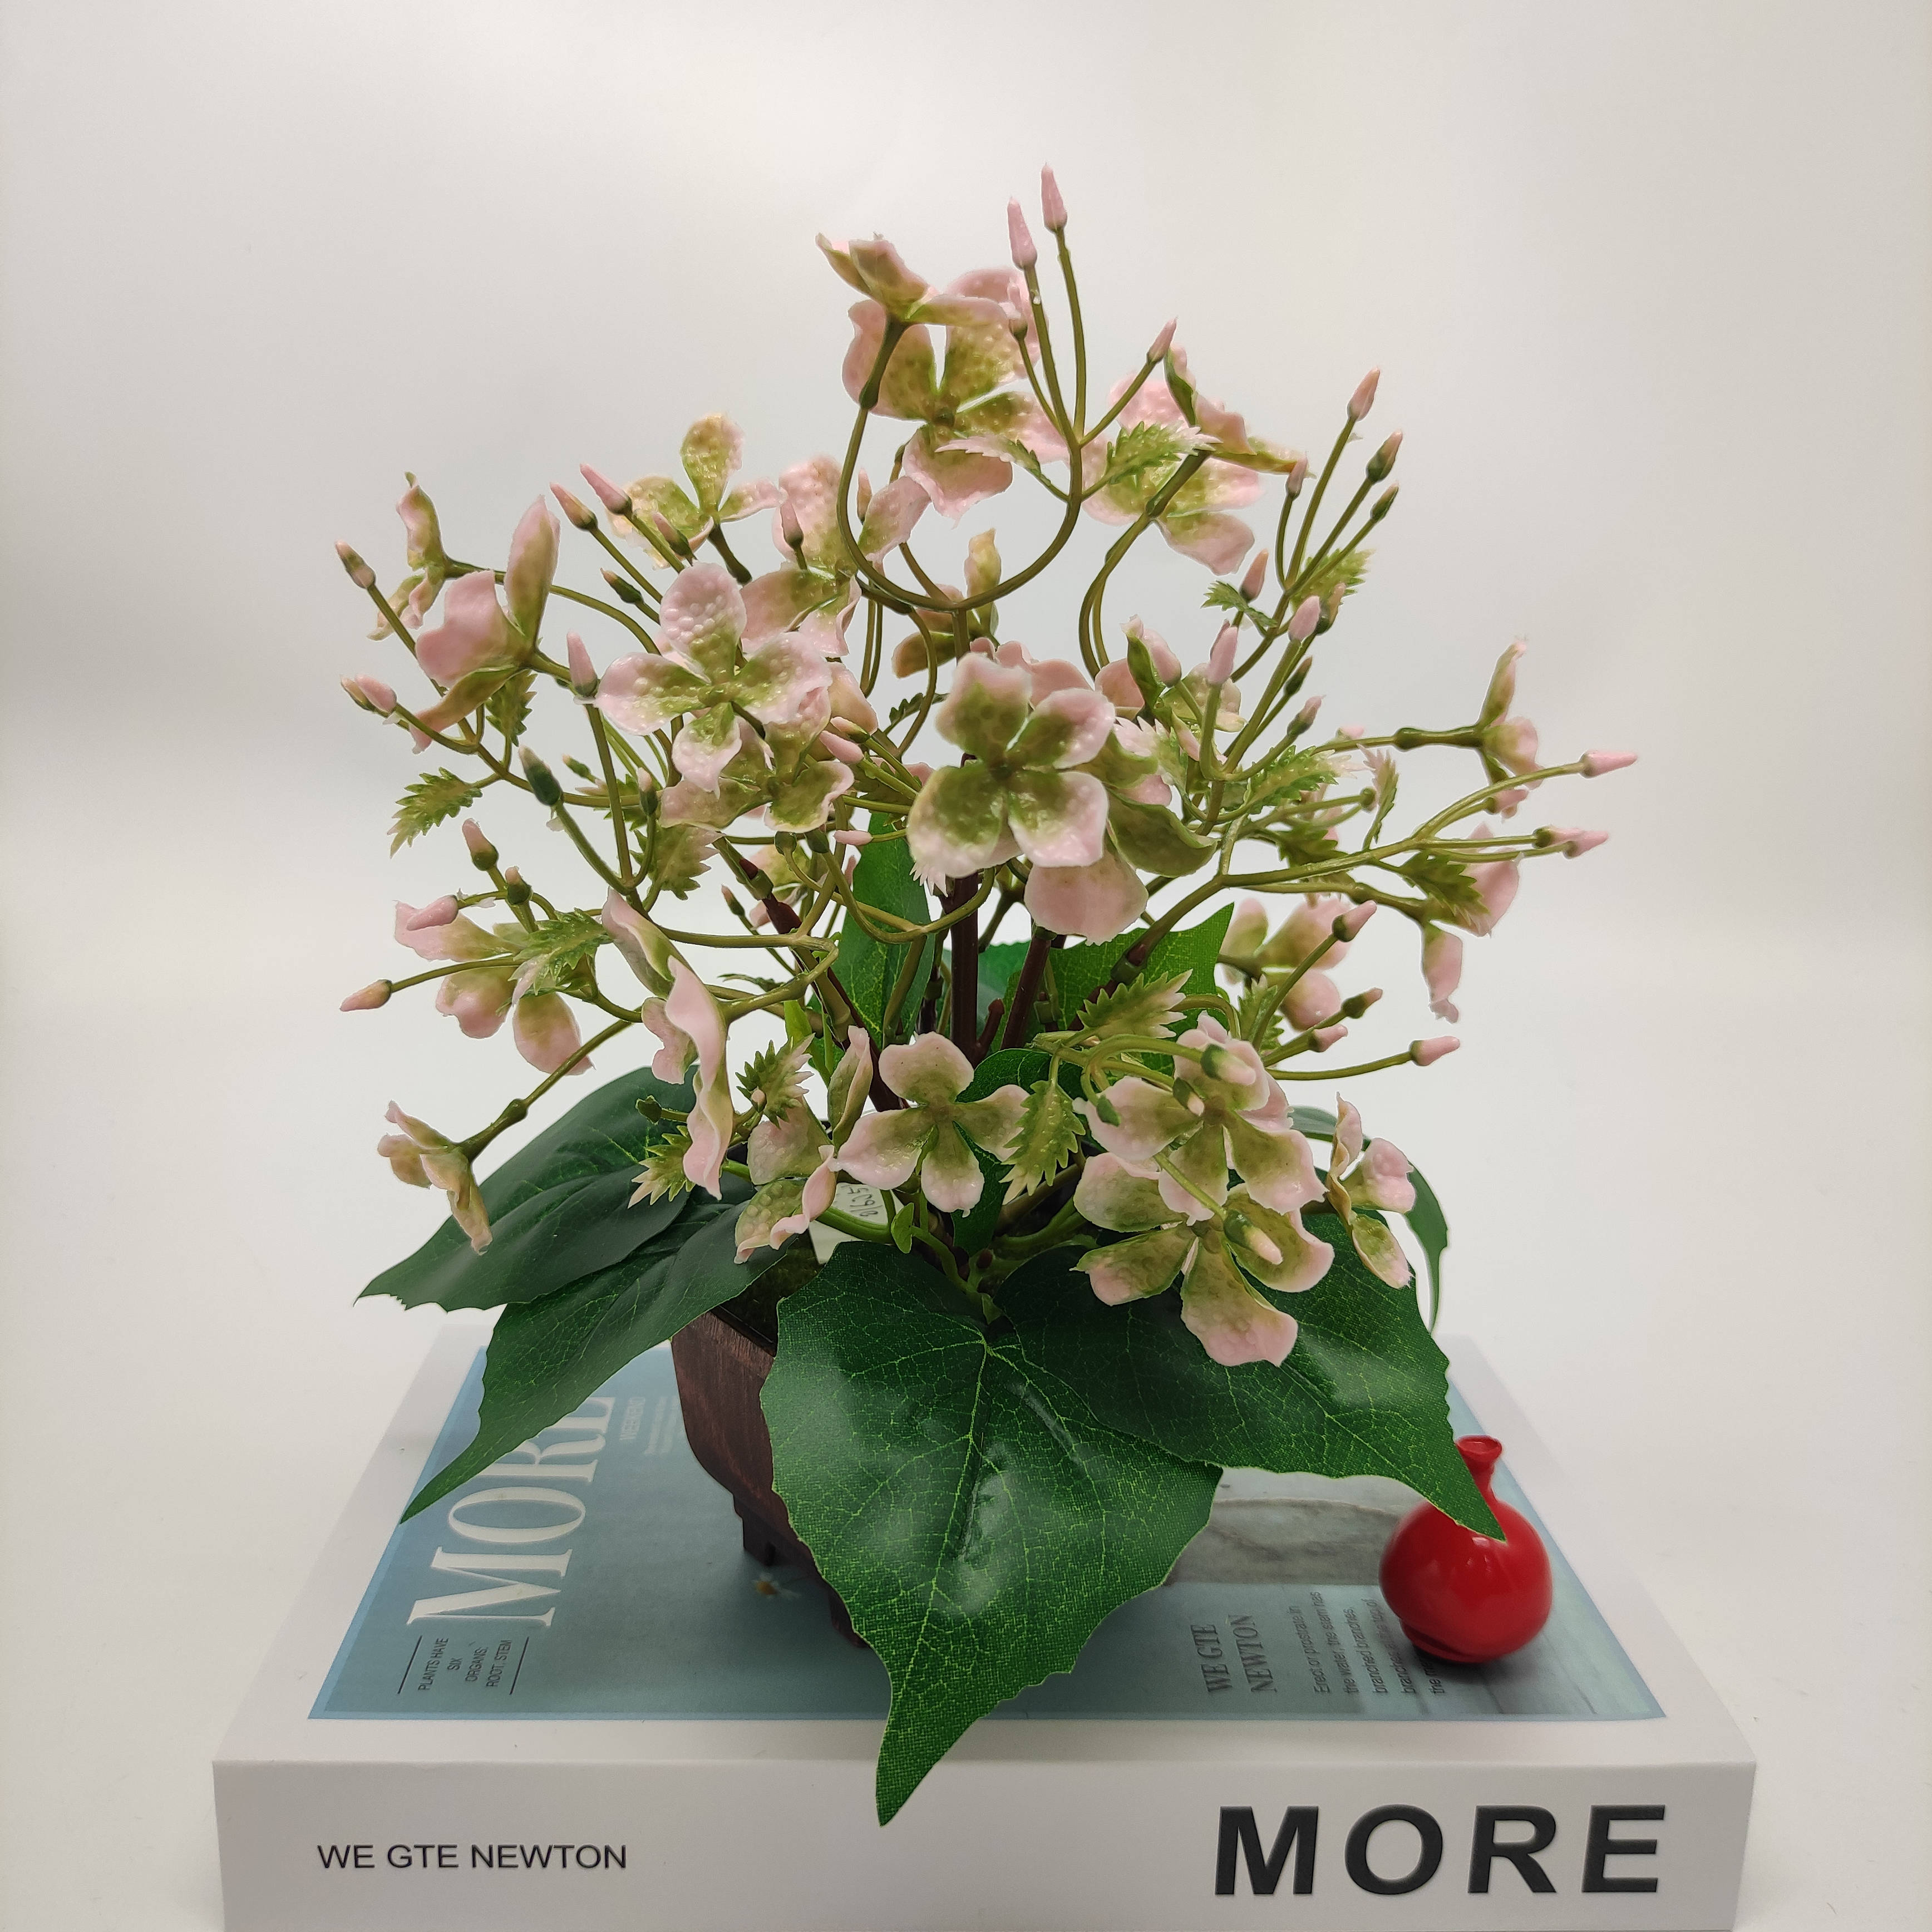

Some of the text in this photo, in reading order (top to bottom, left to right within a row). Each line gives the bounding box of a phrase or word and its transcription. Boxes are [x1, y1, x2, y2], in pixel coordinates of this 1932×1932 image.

[1310, 1591, 1325, 1606] has
[1361, 1598, 1378, 1607] of
[1317, 1609, 1334, 1630] stem
[1292, 1616, 1320, 1655] prostrate
[1325, 1632, 1340, 1645] the
[494, 1640, 511, 1660] STEM
[1190, 1624, 1233, 1693] WE GTE
[1228, 1614, 1278, 1693] NEWTON
[418, 1638, 449, 1690] PLANTS HAVE
[447, 1658, 462, 1670] SIX
[1309, 1657, 1320, 1666] or
[1356, 1650, 1388, 1693] branched
[1310, 1668, 1330, 1694] Erect
[1343, 1678, 1359, 1694] the
[1428, 1678, 1446, 1694] the
[317, 1844, 627, 1869] WE GTE NEWTON
[1215, 1804, 1665, 1895] MORE
